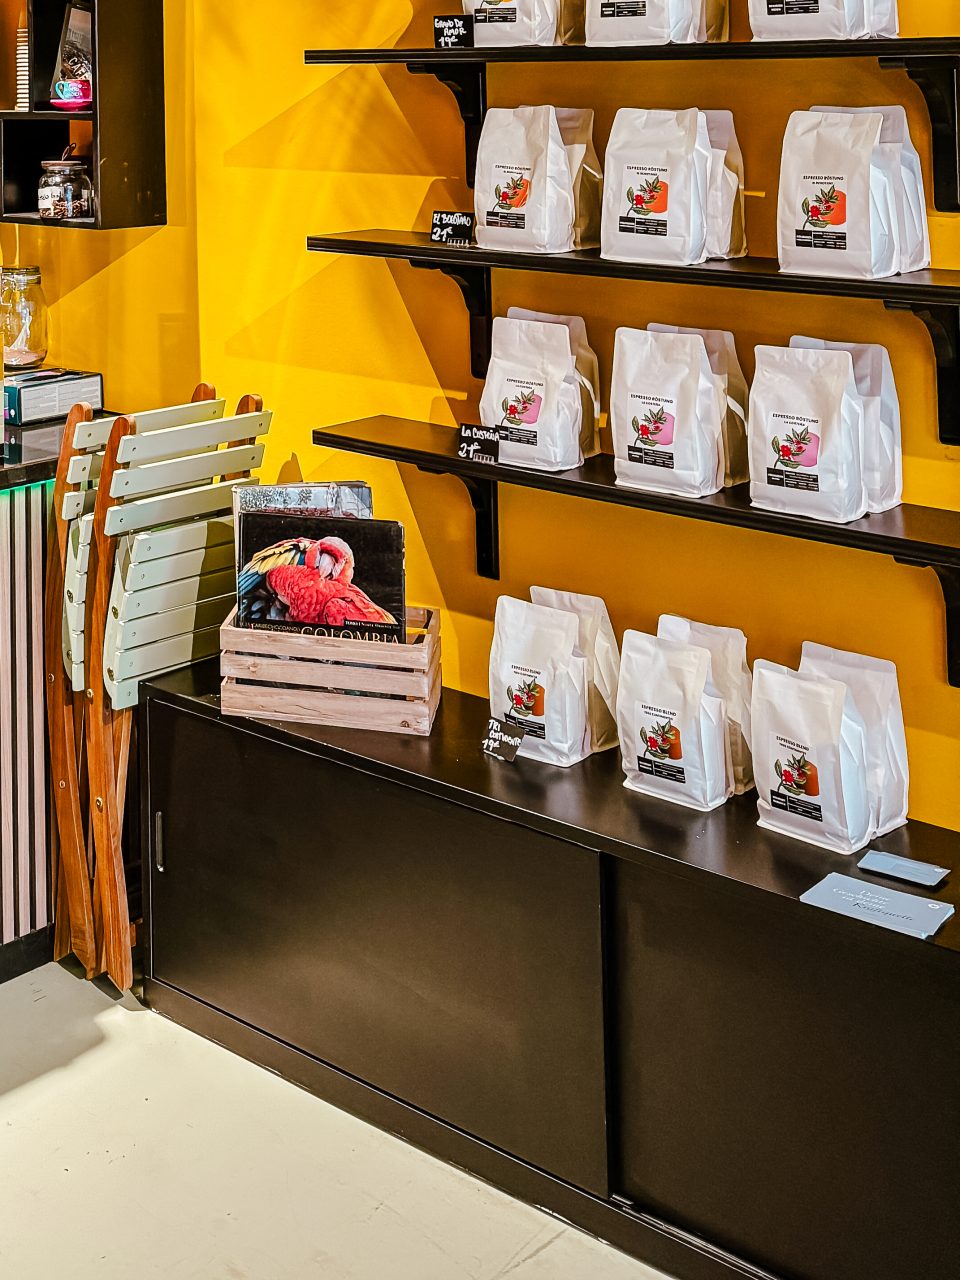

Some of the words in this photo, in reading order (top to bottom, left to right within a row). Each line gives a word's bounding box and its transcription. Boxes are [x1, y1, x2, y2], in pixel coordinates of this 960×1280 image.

[630, 393, 651, 402] ESPRESSO
[300, 626, 399, 645] COLOMBIA
[641, 704, 662, 713] ESPRESSO
[488, 719, 501, 732] TRI
[776, 735, 796, 748] ESPRESSO
